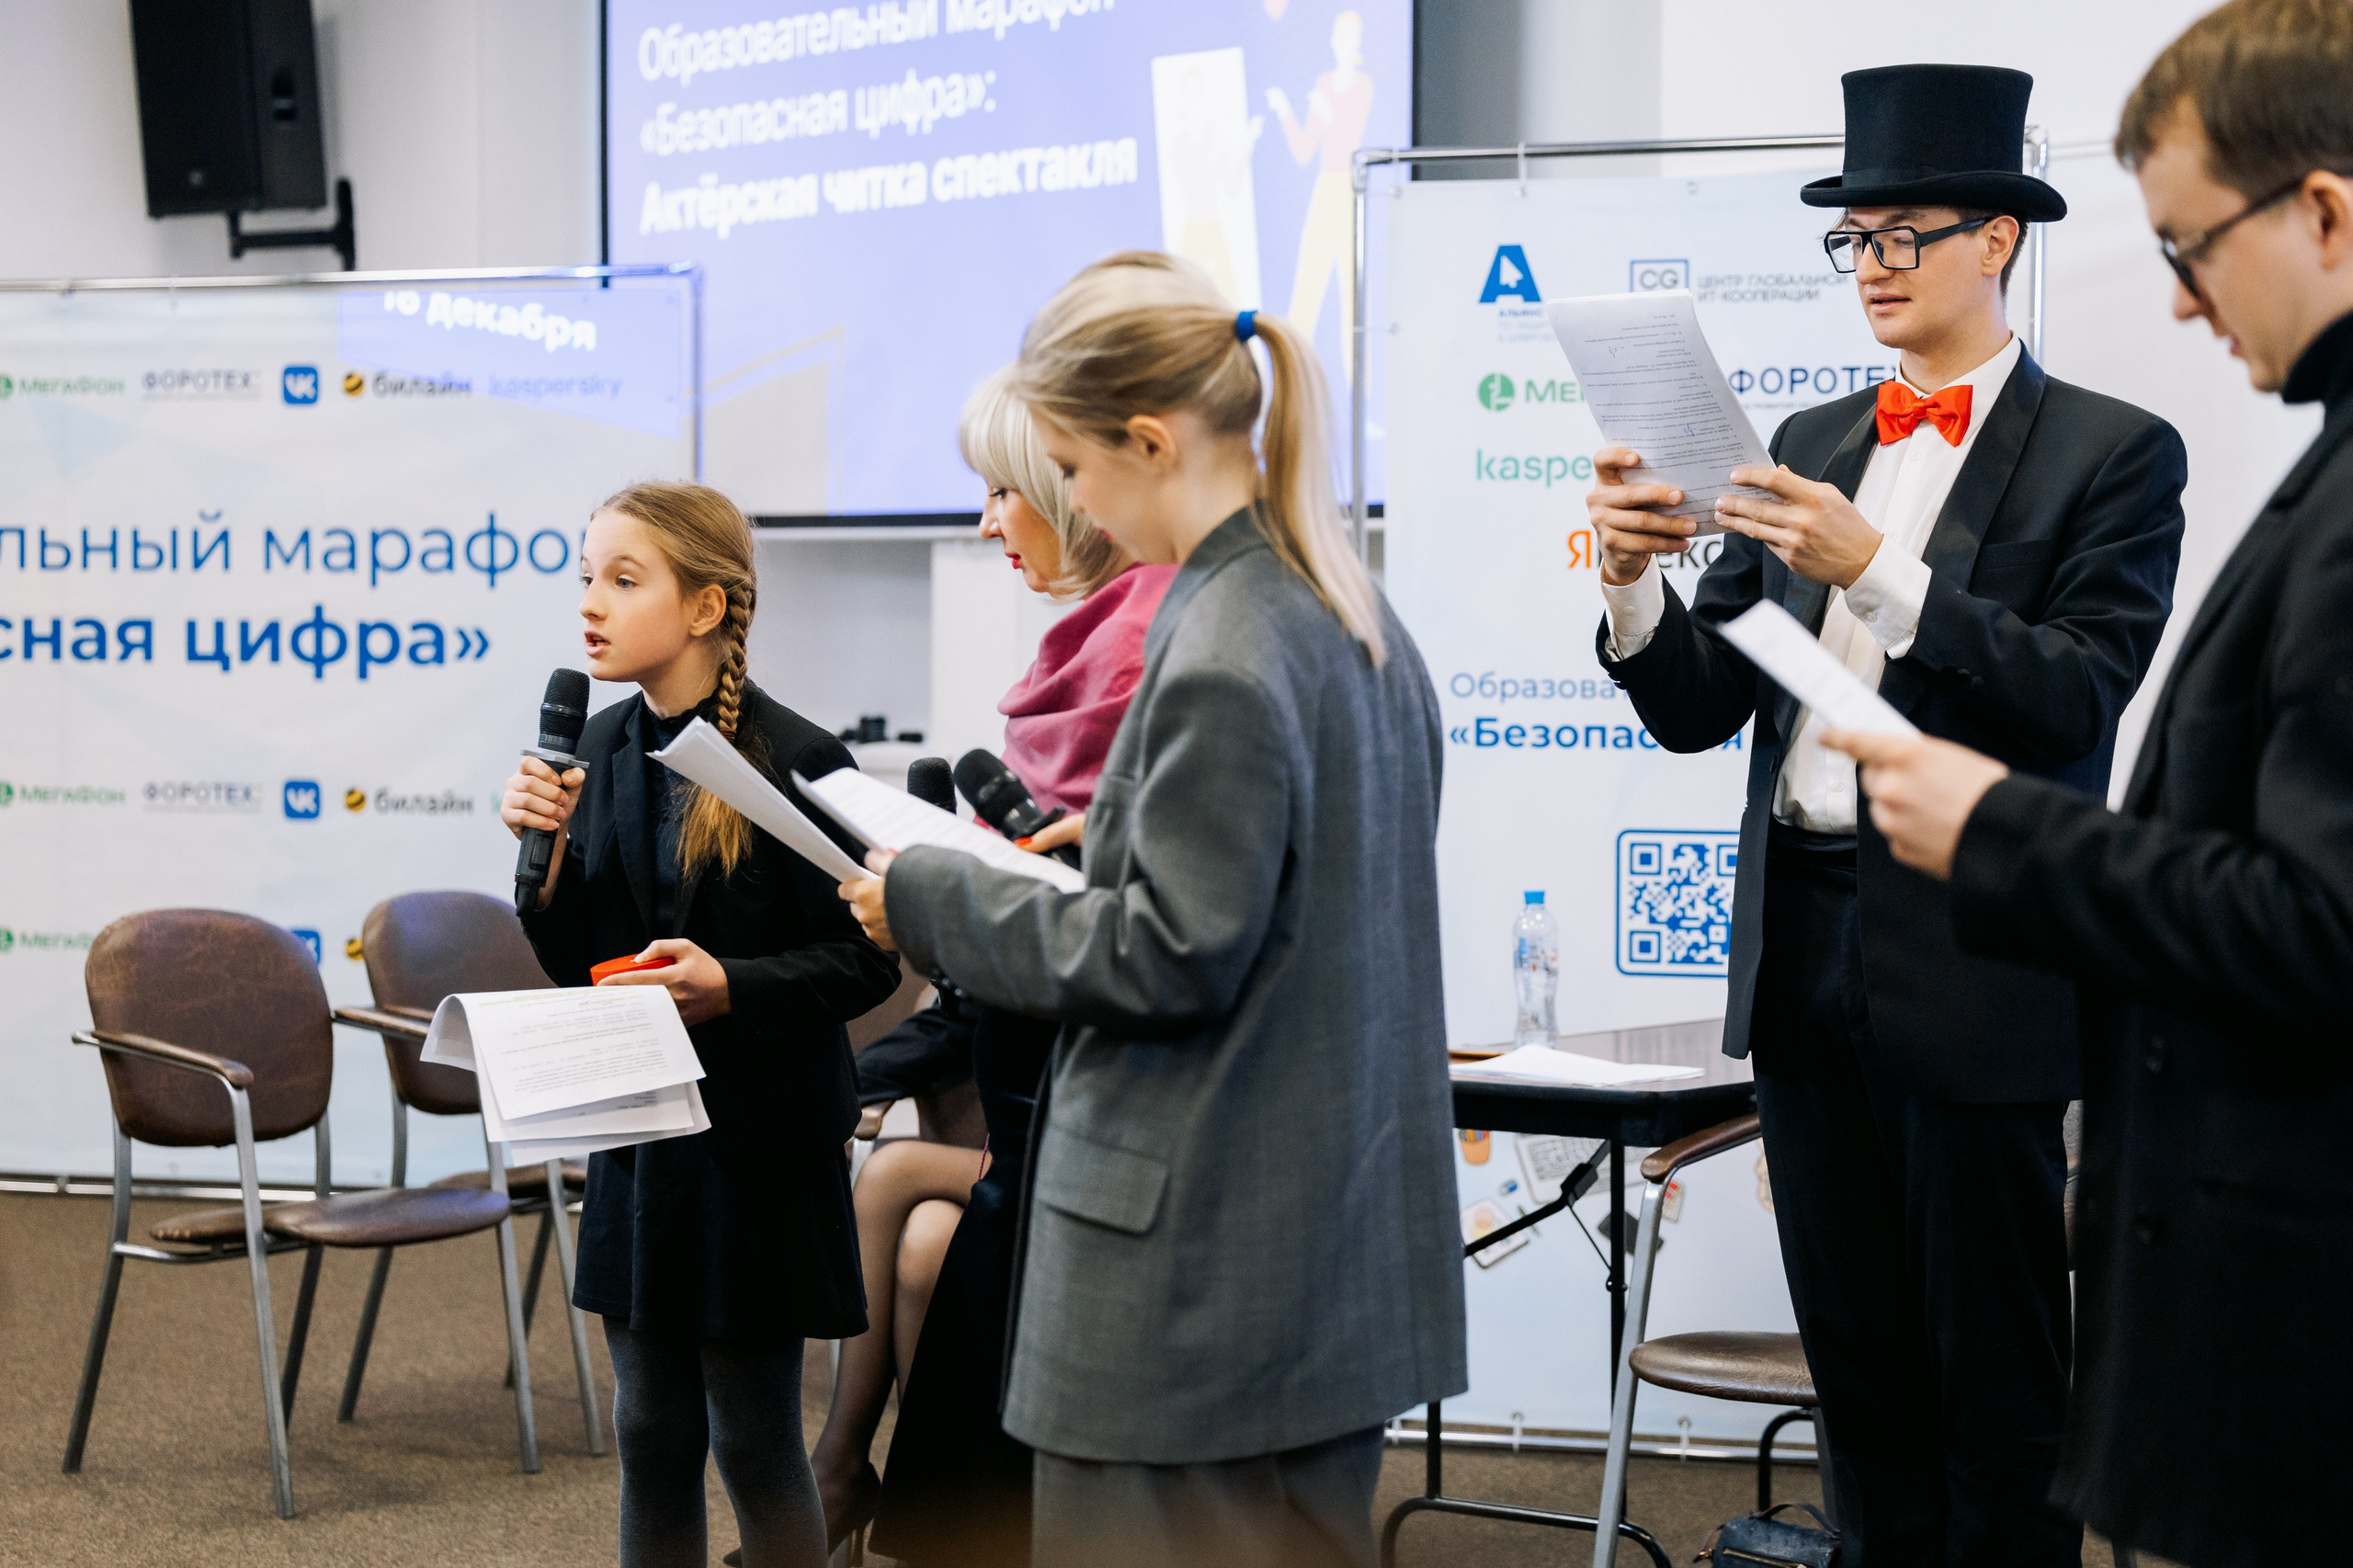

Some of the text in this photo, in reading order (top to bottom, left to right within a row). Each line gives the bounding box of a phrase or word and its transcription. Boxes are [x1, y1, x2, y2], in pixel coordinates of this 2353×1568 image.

[639, 0, 938, 87] Образовательный
[640, 89, 848, 156] «Безопасная
[639, 137, 1138, 240] Актёрская читка спектакля
[1638, 268, 1680, 290] CG
[1697, 271, 1849, 289] ЦЕНТР ГЛОБАЛЬНОЙ
[1697, 288, 1822, 303] ИТ-КООПЕРАЦИИ
[426, 291, 597, 353] декабря
[371, 369, 472, 399] билайн
[1728, 366, 1896, 395] ФОРОТЕ
[1476, 448, 1593, 488] kaspe
[265, 509, 586, 589] марафо
[187, 604, 490, 680] цифра»
[1449, 671, 1627, 704] Образова
[373, 786, 475, 817] билайн
